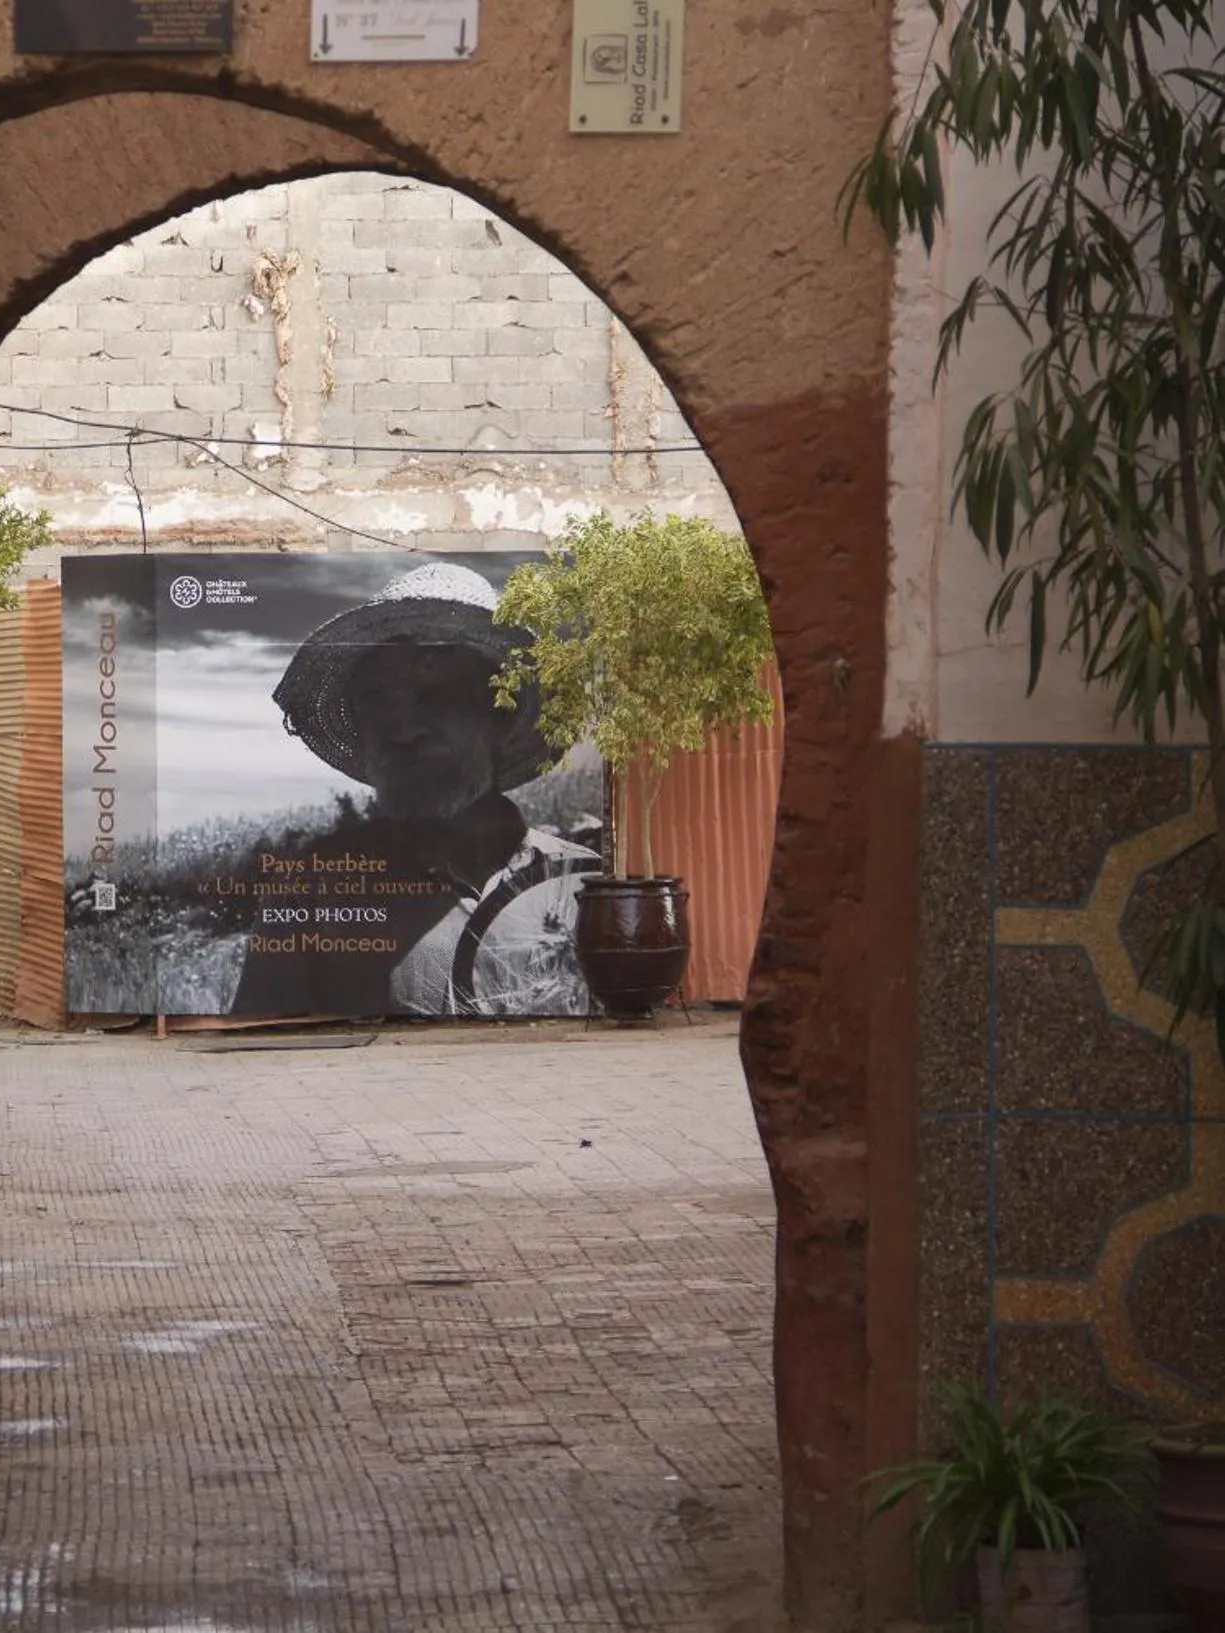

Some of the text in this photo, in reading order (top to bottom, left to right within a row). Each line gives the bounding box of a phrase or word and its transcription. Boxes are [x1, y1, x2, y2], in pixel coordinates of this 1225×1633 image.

[631, 34, 648, 77] Casa
[629, 84, 647, 125] Riad
[91, 612, 117, 864] Riad Monceau
[261, 852, 388, 879] Pays berbère
[215, 876, 246, 895] Un
[252, 877, 310, 896] musée
[317, 878, 329, 895] à
[334, 875, 367, 895] ciel
[372, 879, 434, 895] ouvert
[262, 907, 388, 923] EXPO PHOTOS
[249, 932, 397, 953] Riad Monceau
